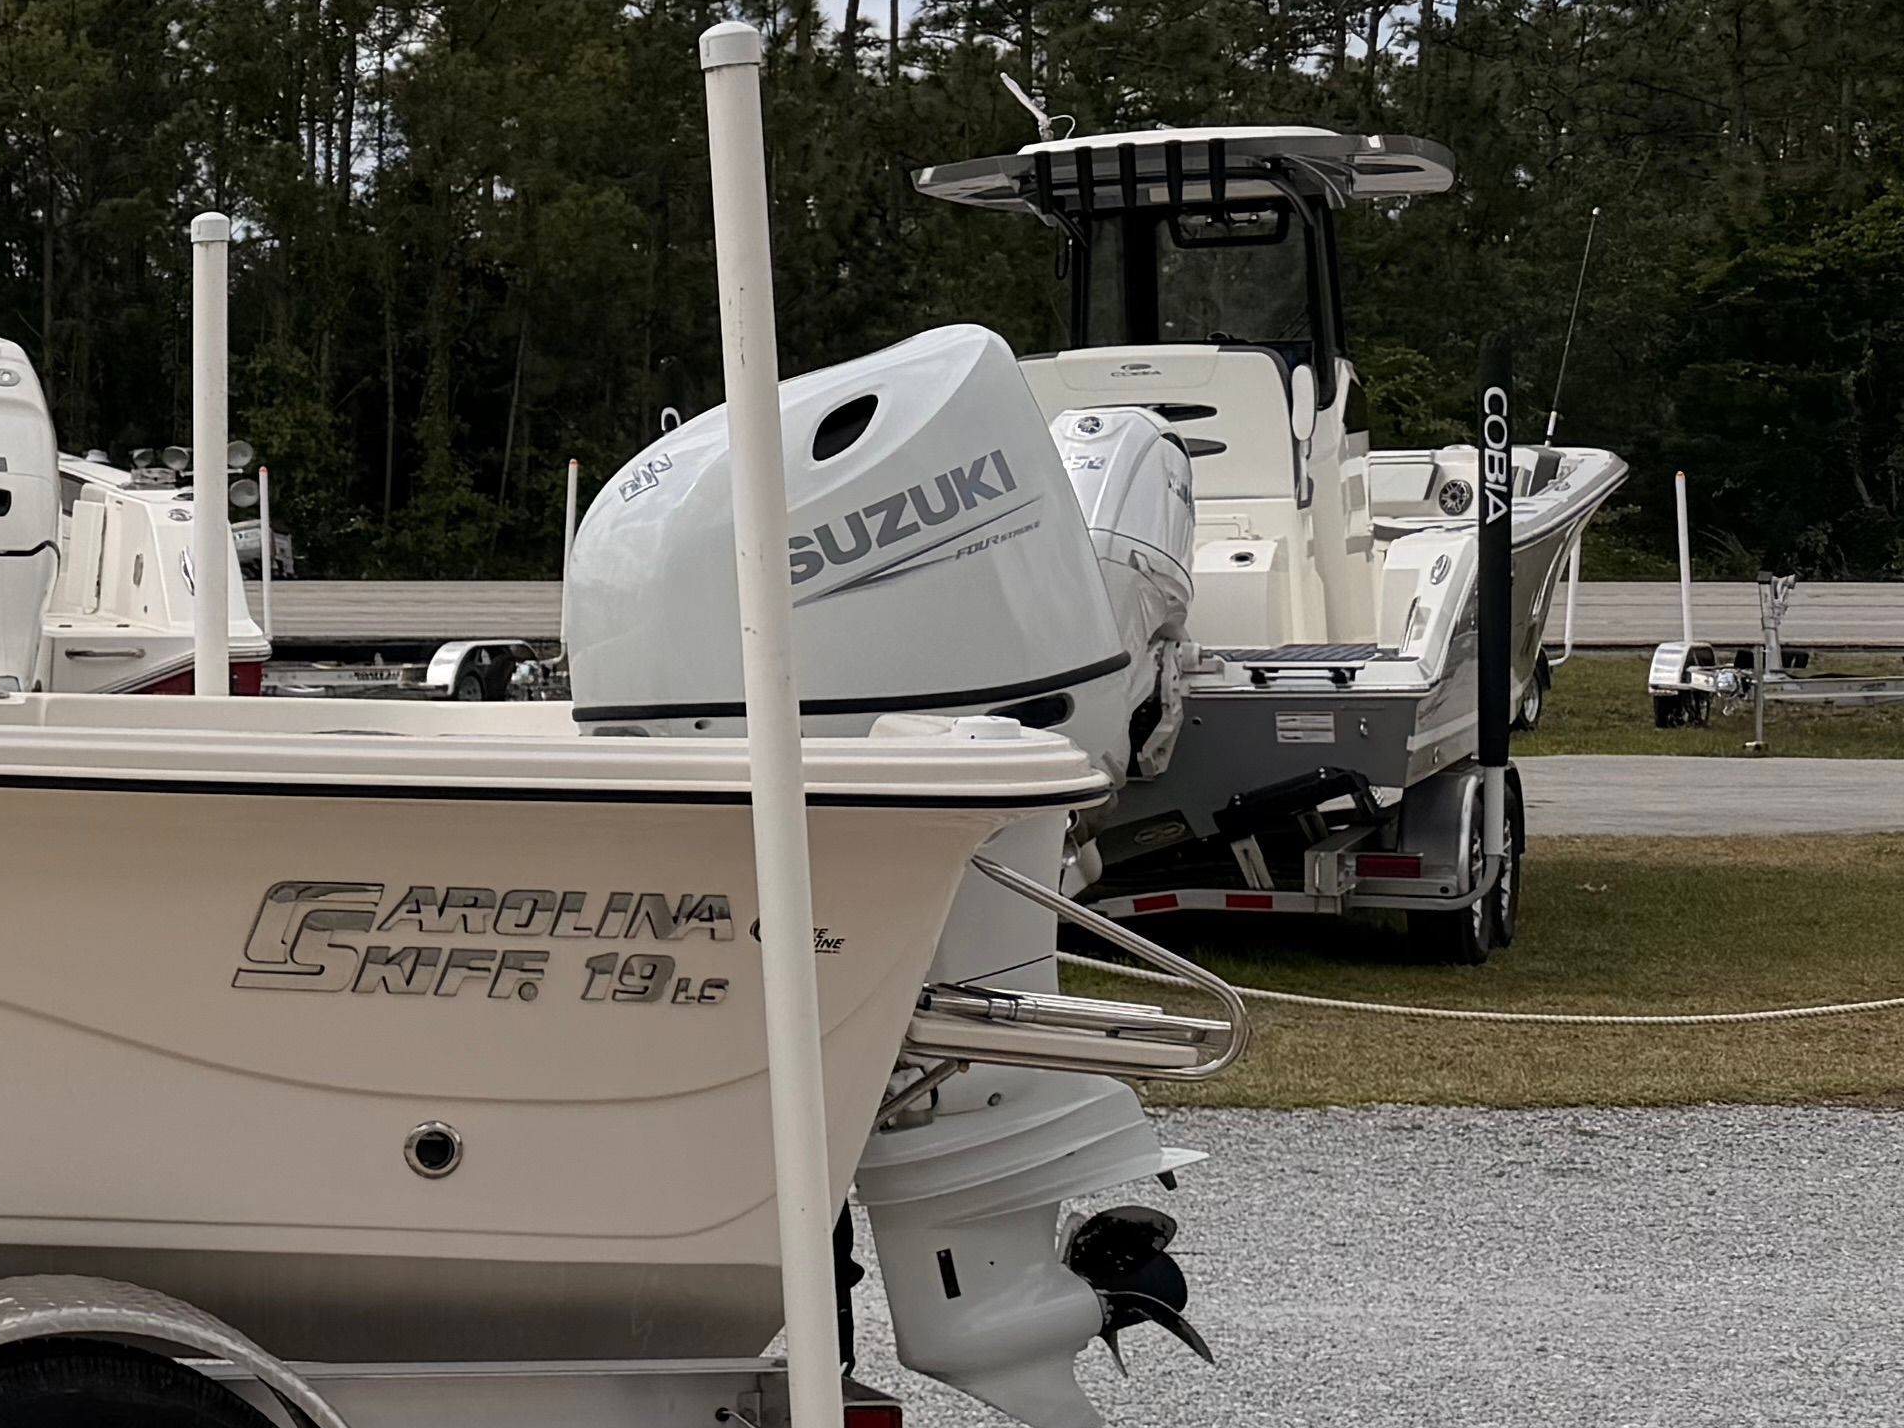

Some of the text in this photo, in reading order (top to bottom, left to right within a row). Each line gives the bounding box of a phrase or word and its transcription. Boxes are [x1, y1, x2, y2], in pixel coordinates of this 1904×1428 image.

[1484, 386, 1508, 525] COBIA
[788, 448, 1018, 586] SUZUKI
[231, 909, 730, 1004] SKIFF 19 LS
[245, 880, 735, 964] CAROLINA
